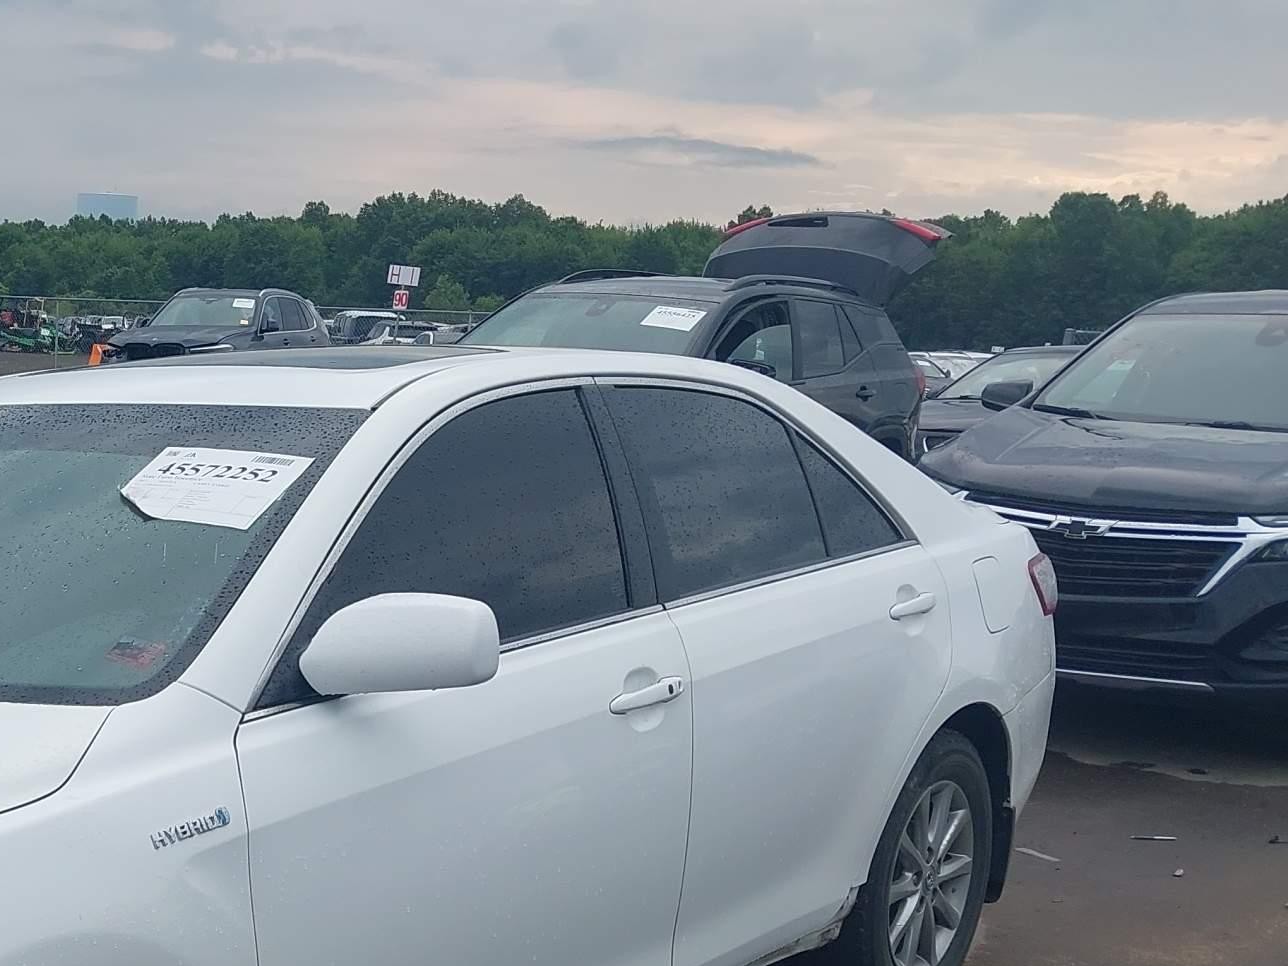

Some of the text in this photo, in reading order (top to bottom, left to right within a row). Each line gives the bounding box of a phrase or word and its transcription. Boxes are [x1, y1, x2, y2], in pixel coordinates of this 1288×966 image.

[394, 292, 408, 307] 90
[158, 462, 280, 483] 45572252
[150, 806, 231, 850] HYBRID
